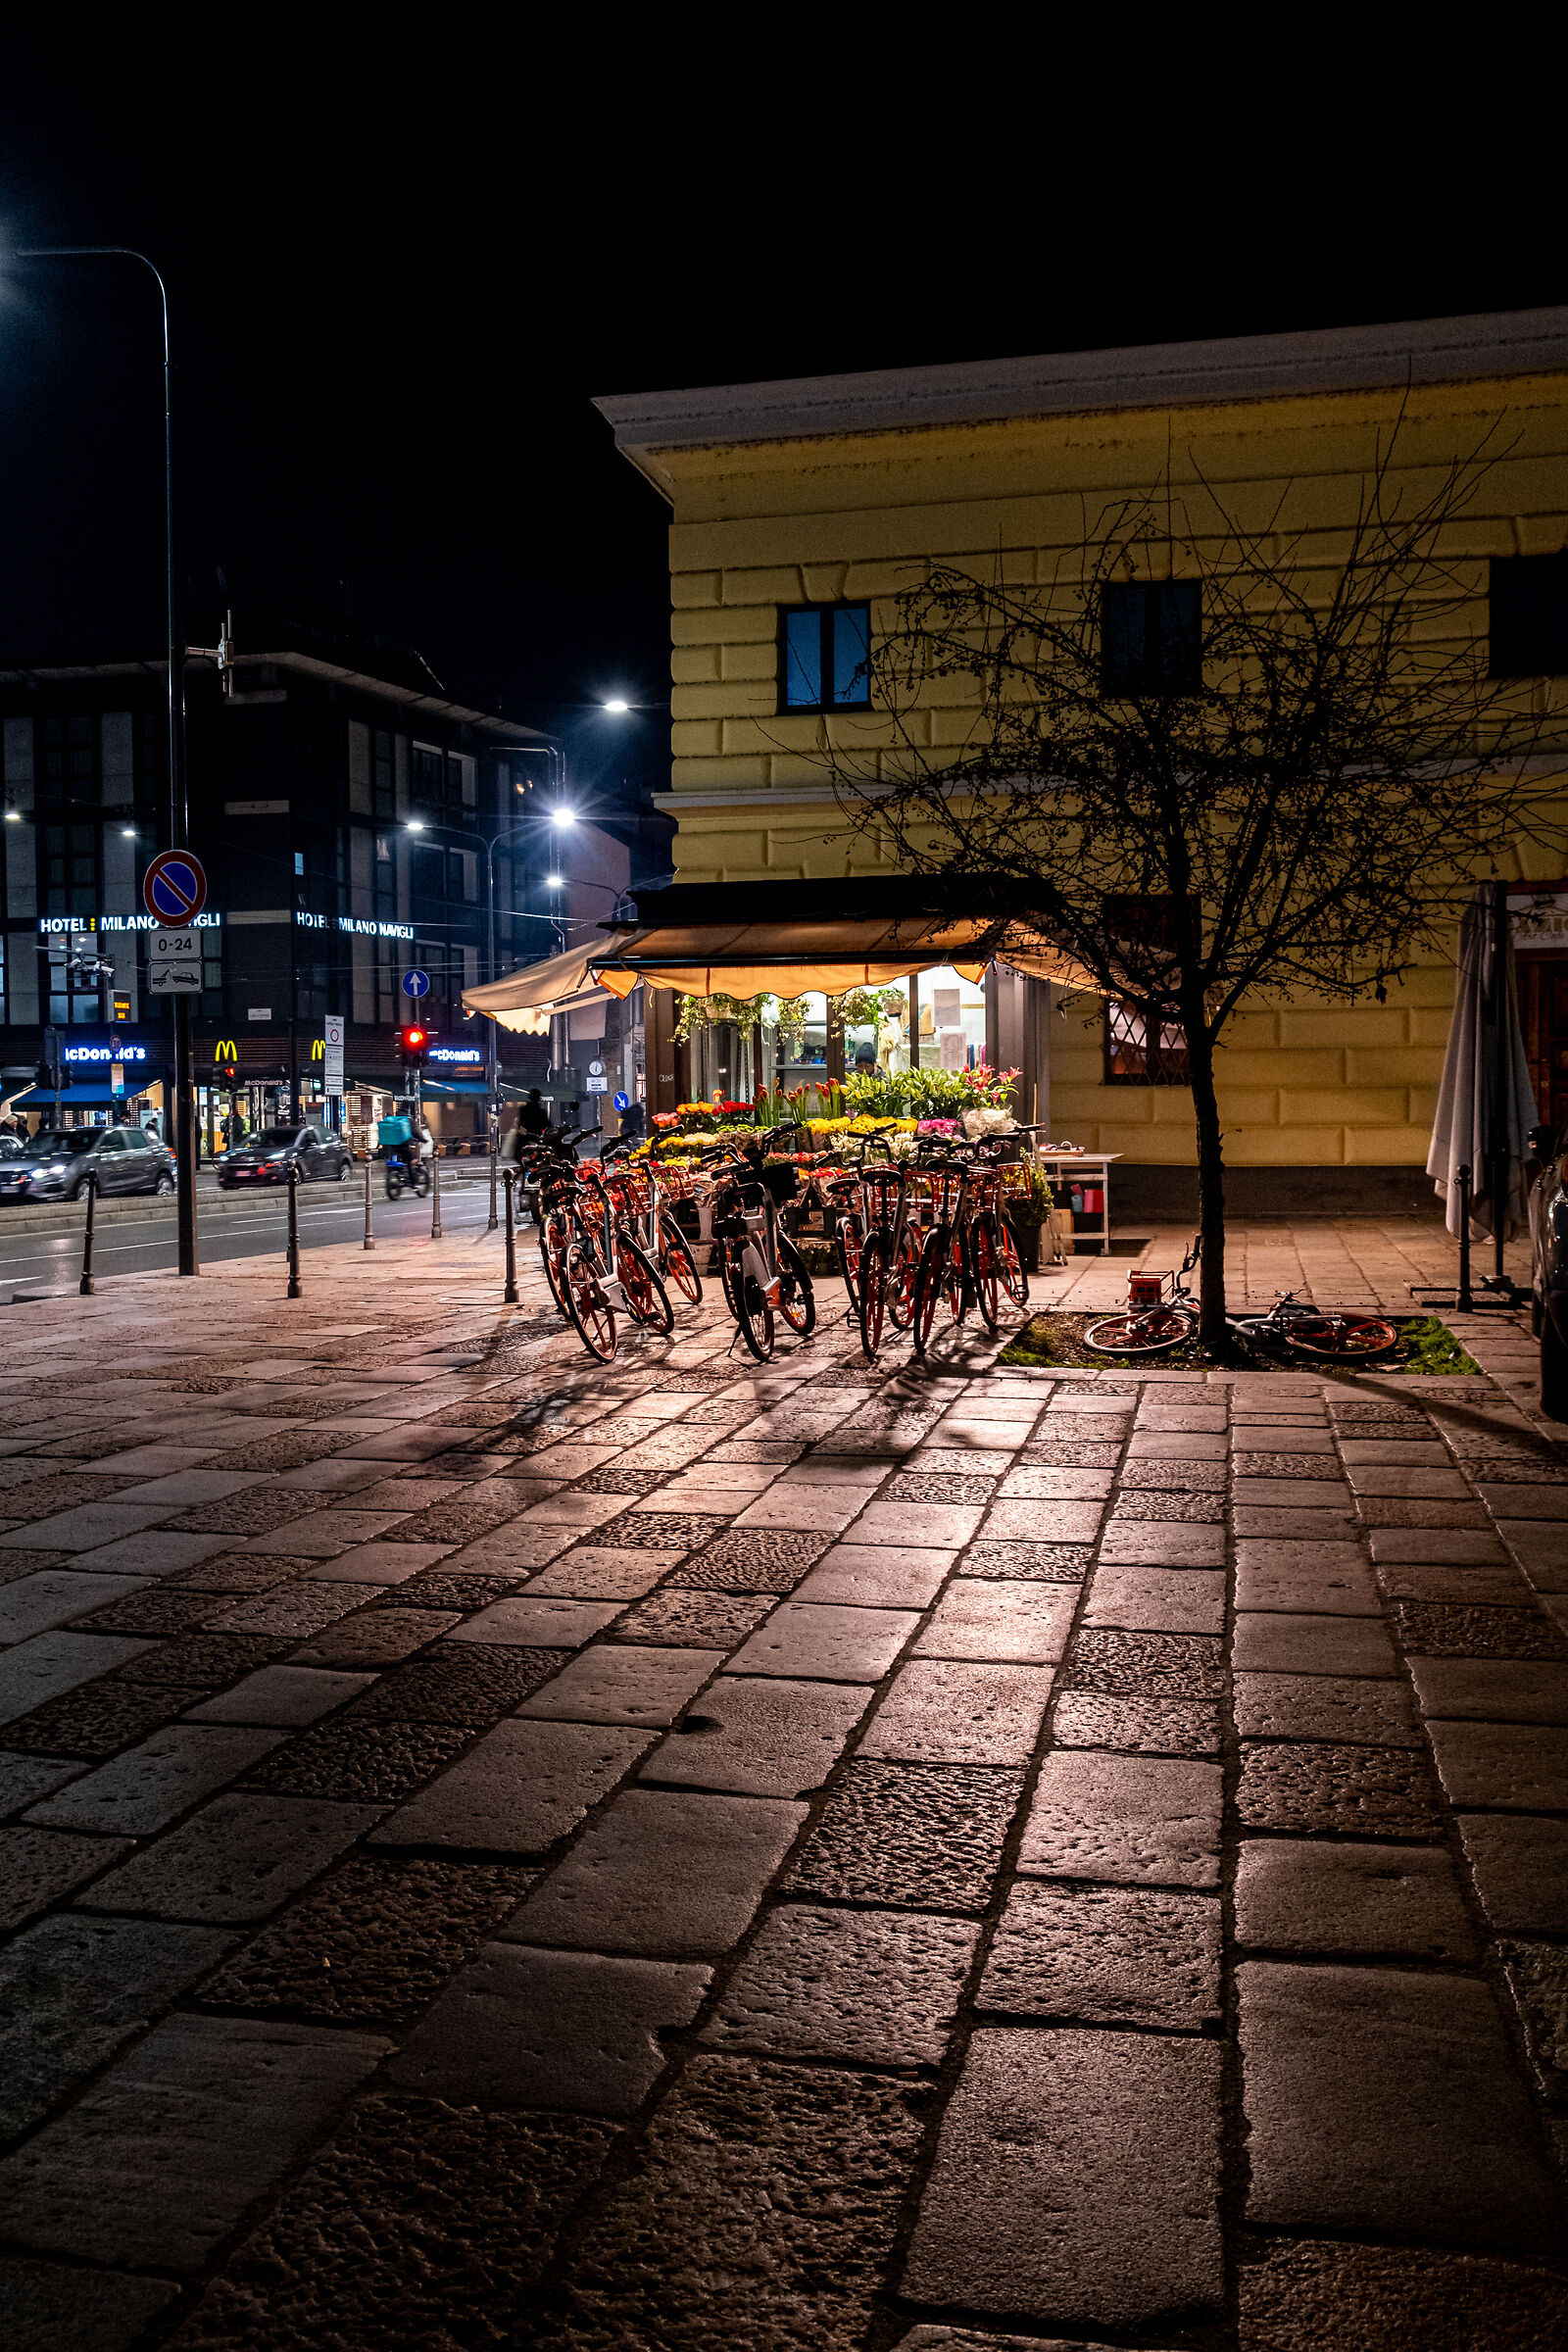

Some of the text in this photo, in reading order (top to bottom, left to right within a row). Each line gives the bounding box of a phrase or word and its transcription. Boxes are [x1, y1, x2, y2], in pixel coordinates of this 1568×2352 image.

[40, 918, 87, 933] HOTEL
[101, 915, 159, 931] MILANO
[296, 911, 414, 940] HOTEL MILANO NAVIGLI
[158, 937, 193, 952] 0-24
